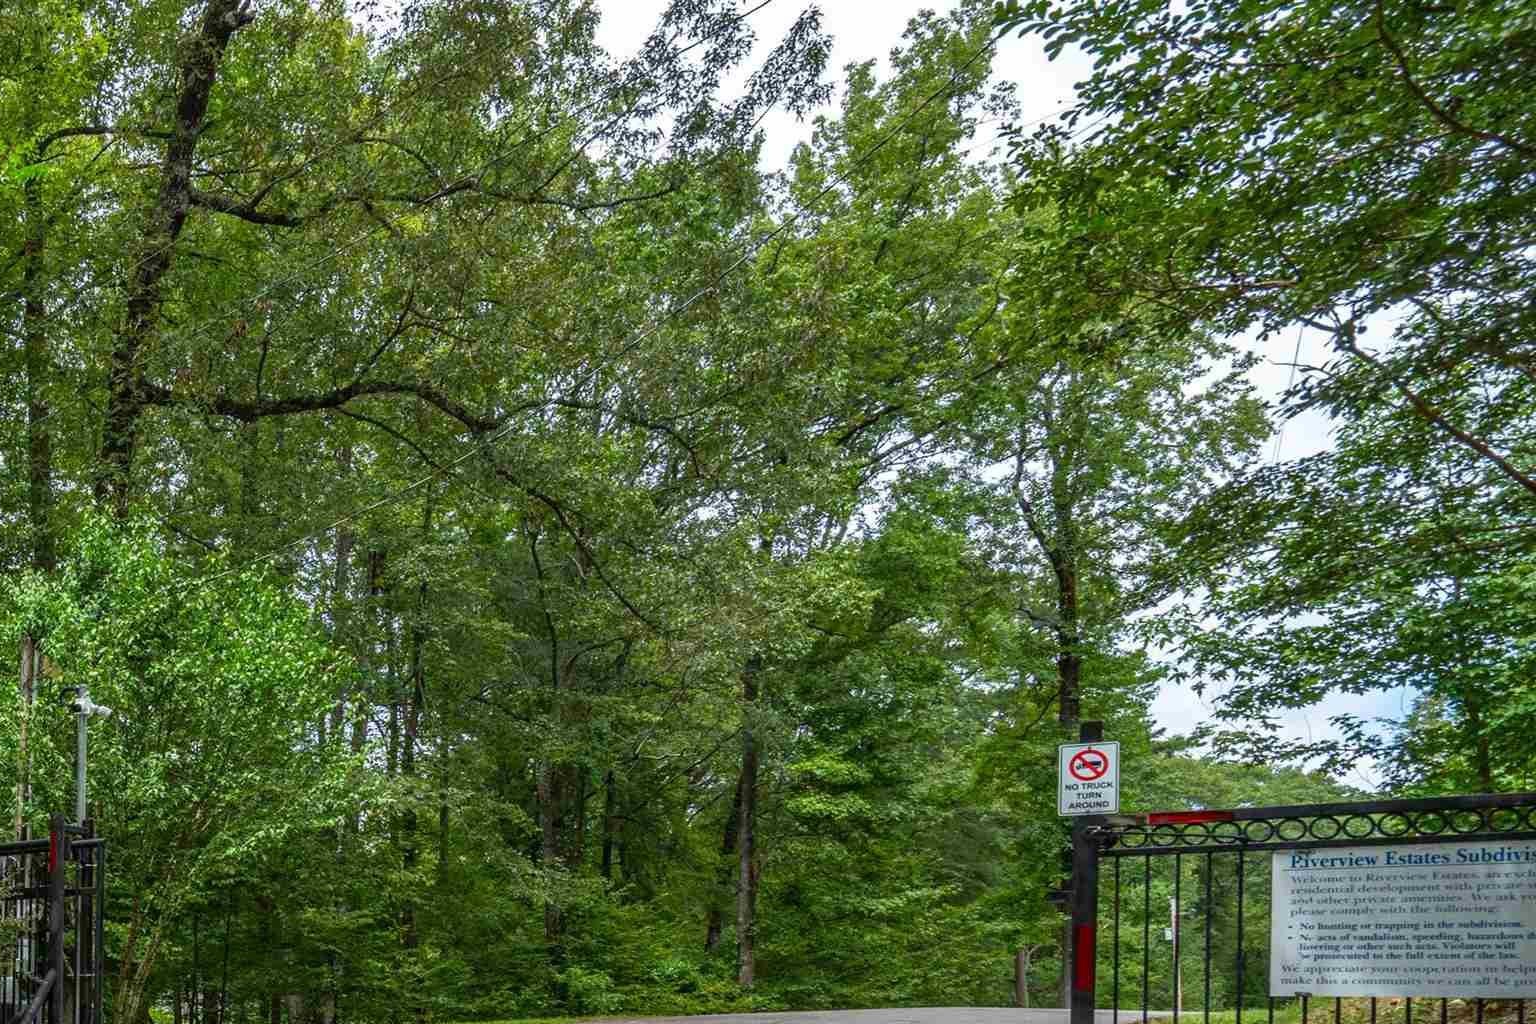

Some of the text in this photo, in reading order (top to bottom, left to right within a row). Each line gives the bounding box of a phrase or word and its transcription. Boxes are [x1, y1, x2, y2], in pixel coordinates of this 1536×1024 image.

[1069, 801, 1110, 809] AROUND
[1291, 852, 1377, 868] Riverview
[1385, 849, 1450, 865] Estates
[1291, 874, 1345, 883] Welcome
[1350, 873, 1362, 882] to
[1366, 872, 1427, 882] Riverview
[1291, 883, 1354, 896] residential
[1357, 882, 1441, 895] development
[1445, 881, 1472, 891] with
[1476, 881, 1521, 893] private
[1289, 895, 1312, 905] and
[1315, 895, 1352, 904] other
[1353, 894, 1396, 907] private
[1471, 892, 1489, 902] We
[1495, 891, 1516, 901] ask
[1290, 905, 1327, 917] please
[1330, 904, 1376, 917] comply
[1379, 903, 1406, 914] with
[1410, 904, 1432, 913] the
[1317, 922, 1358, 932] hunting
[1375, 922, 1420, 932] trapping
[1423, 921, 1434, 929] in
[1438, 920, 1456, 929] the
[1340, 933, 1351, 941] of
[1467, 931, 1524, 940] hazardous
[1356, 943, 1385, 951] other
[1388, 942, 1412, 950] such
[1443, 941, 1492, 950] Violators
[1495, 941, 1516, 949] will
[1313, 952, 1370, 961] prosecuted
[1406, 951, 1424, 959] full
[1478, 951, 1497, 959] the
[1303, 966, 1367, 974] appreciate
[1281, 976, 1312, 984] make
[1316, 976, 1337, 984] this
[1352, 977, 1422, 986] community
